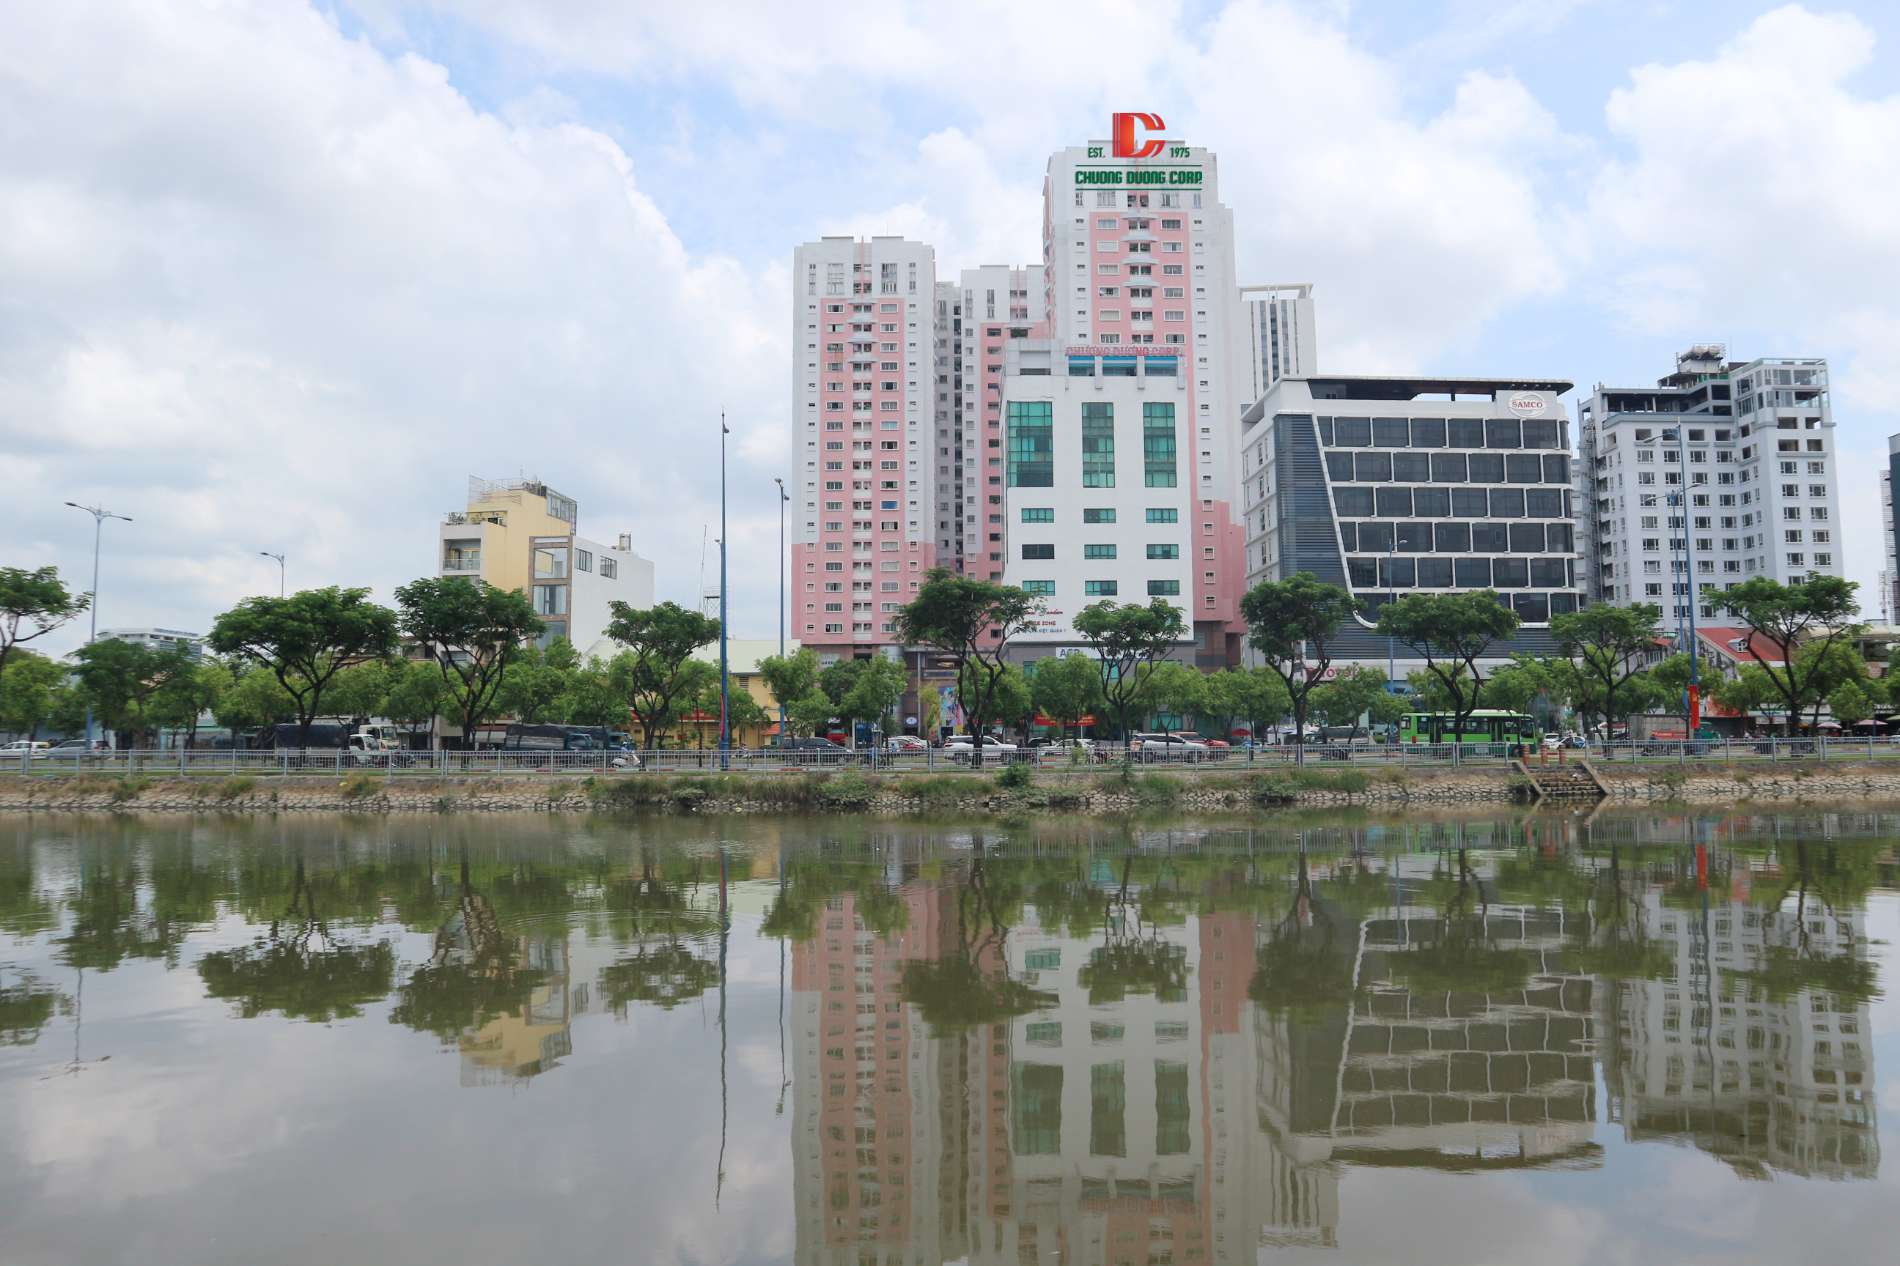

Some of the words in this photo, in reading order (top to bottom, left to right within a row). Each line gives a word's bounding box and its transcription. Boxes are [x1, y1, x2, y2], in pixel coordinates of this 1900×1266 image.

[1088, 147, 1105, 158] EST.
[1170, 147, 1190, 158] 1975
[1075, 171, 1123, 185] CHUONG
[1126, 171, 1166, 185] DUONG
[1168, 171, 1203, 185] CORP.
[1512, 401, 1542, 409] SAMCO
